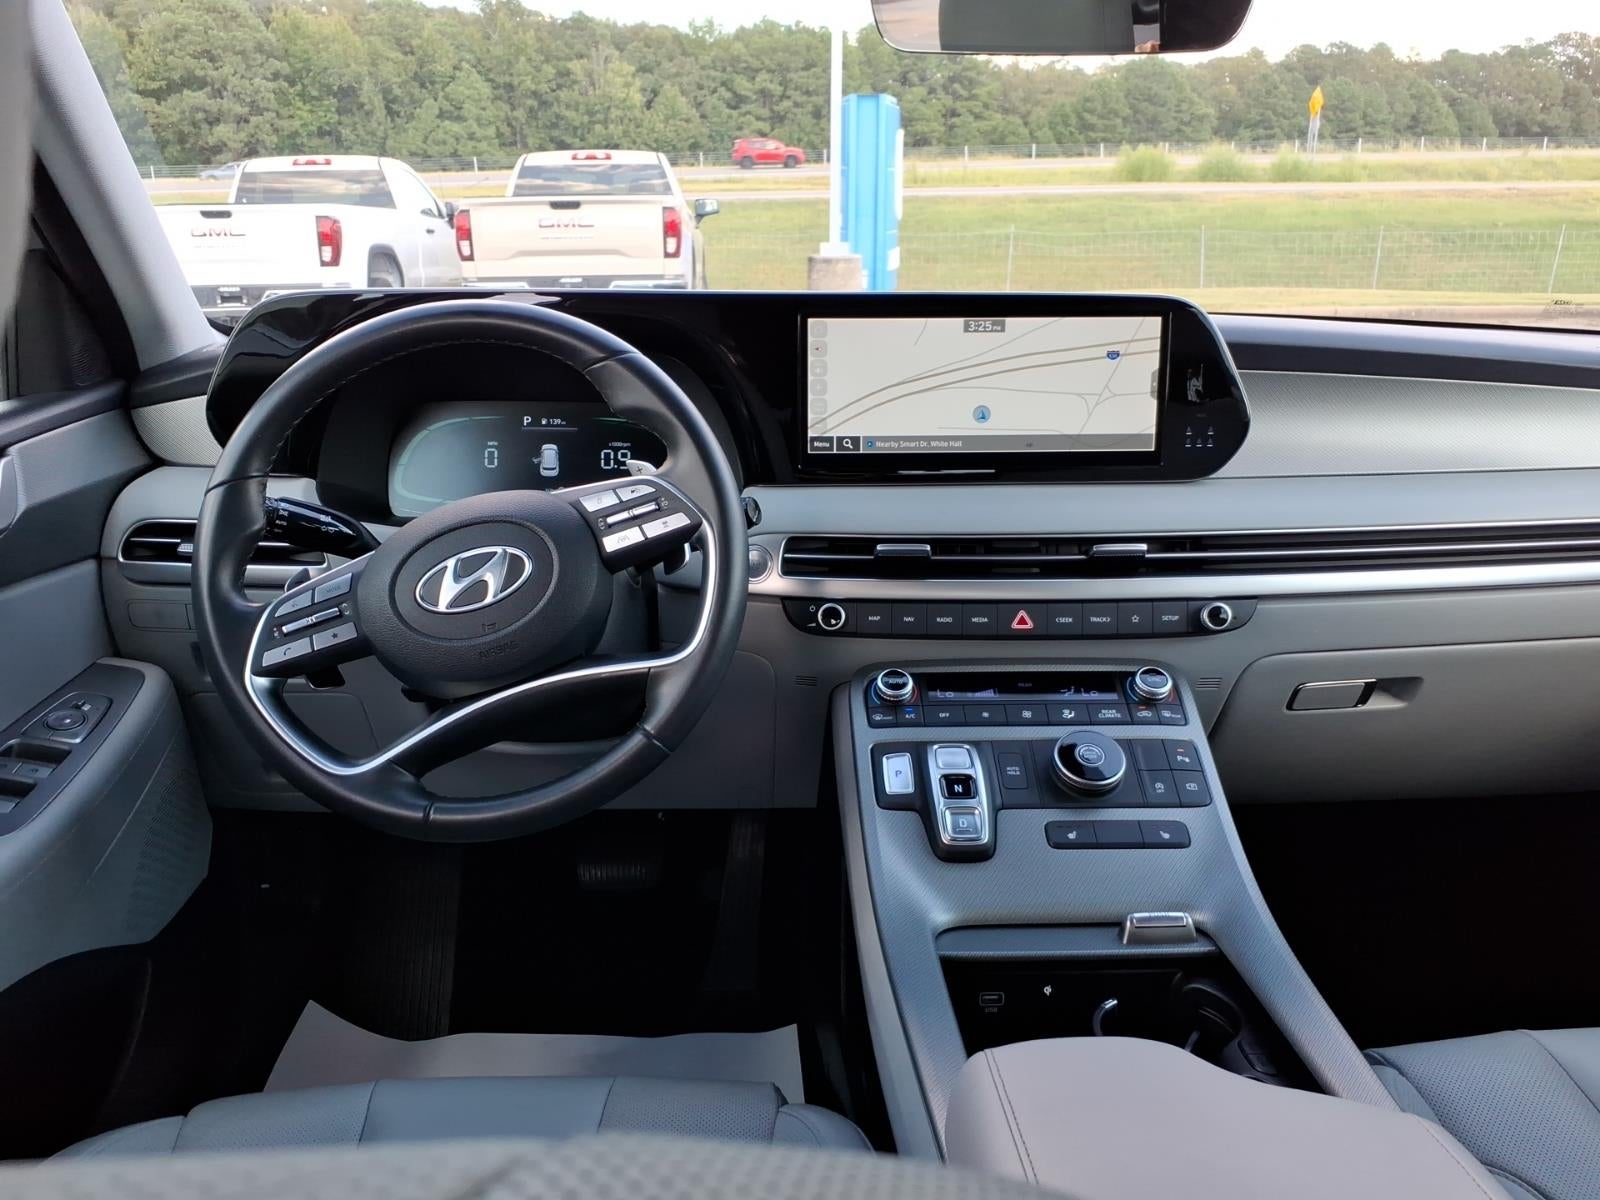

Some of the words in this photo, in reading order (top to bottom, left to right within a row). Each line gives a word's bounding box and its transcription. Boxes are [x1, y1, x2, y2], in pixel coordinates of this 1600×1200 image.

[967, 320, 992, 332] 3:25
[523, 416, 532, 426] P
[813, 440, 830, 448] Menu
[875, 440, 899, 450] Nearby
[900, 439, 919, 448] Smart
[930, 439, 948, 448] White
[949, 439, 963, 448] Hall
[484, 448, 498, 468] 0
[954, 784, 963, 793] N
[959, 818, 968, 828] D
